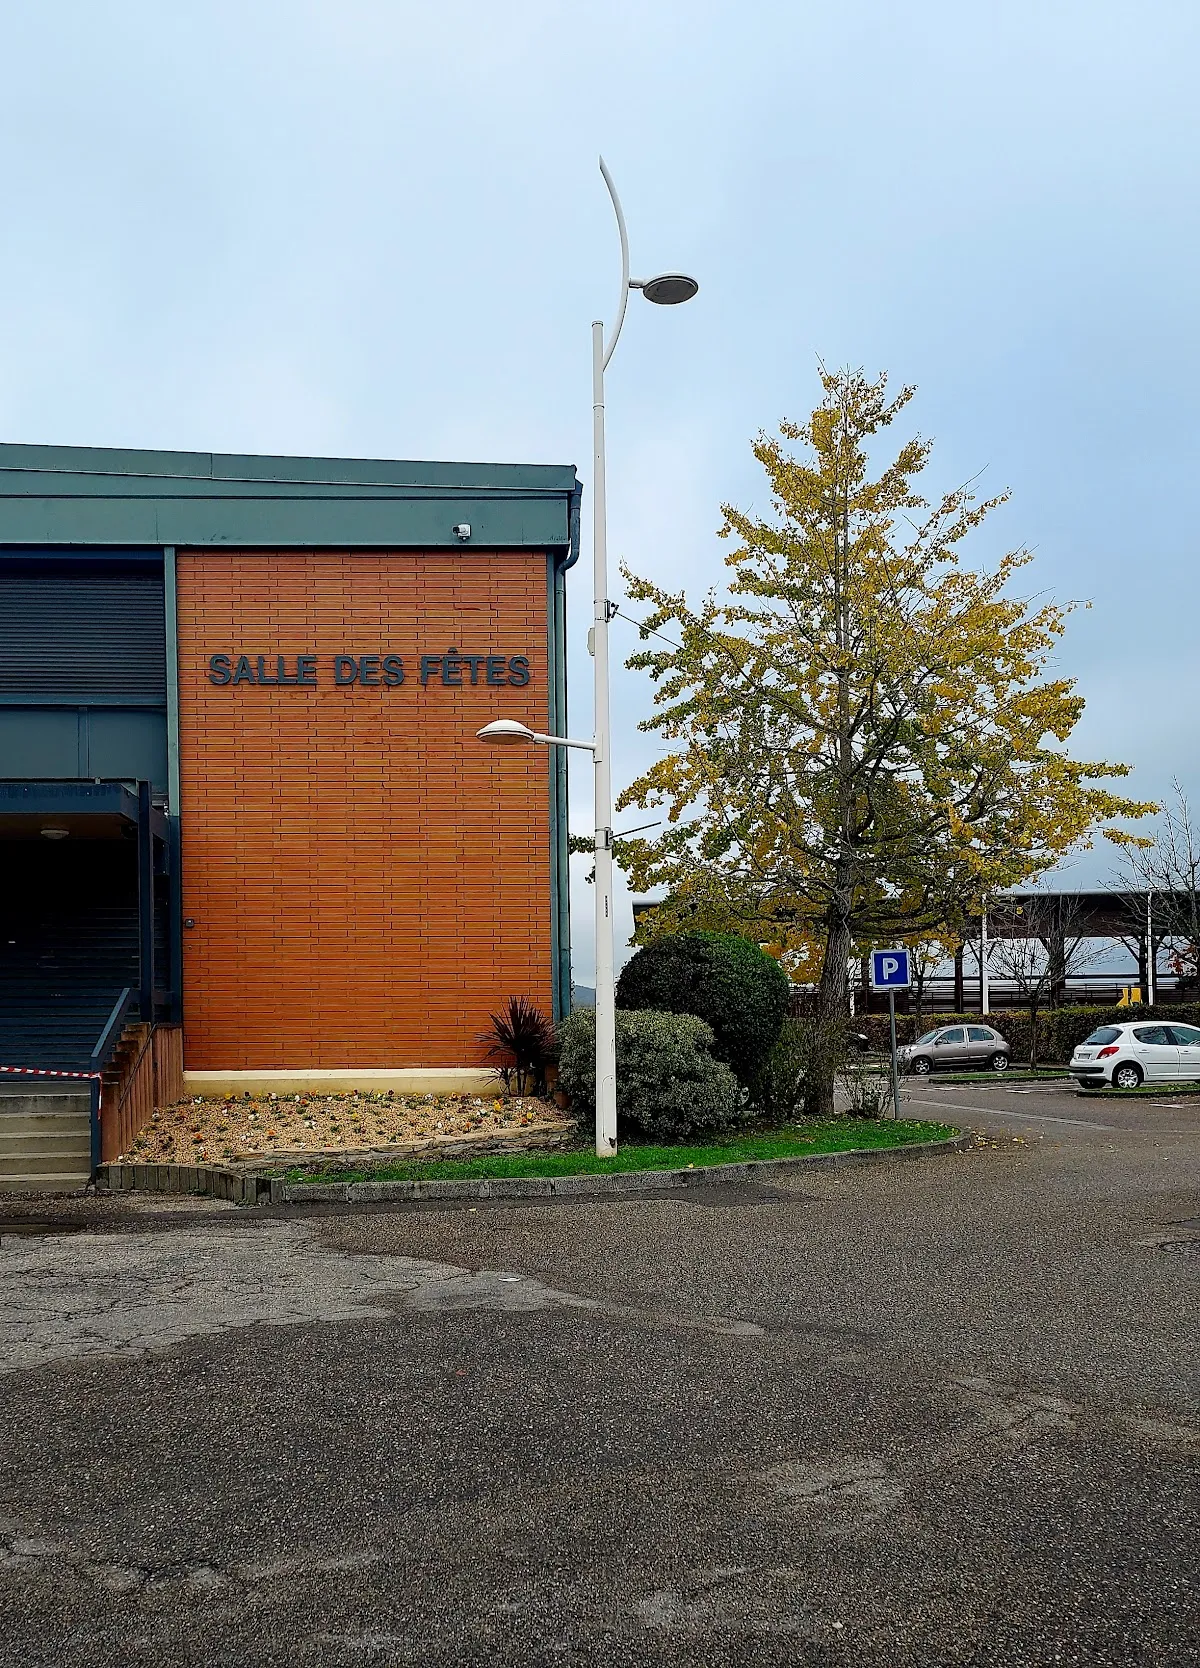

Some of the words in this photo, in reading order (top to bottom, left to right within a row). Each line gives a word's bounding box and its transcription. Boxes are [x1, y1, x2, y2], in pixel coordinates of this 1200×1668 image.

[209, 655, 317, 684] SALLE
[334, 655, 404, 685] DES
[421, 648, 530, 685] FÊTES
[883, 958, 898, 980] P
